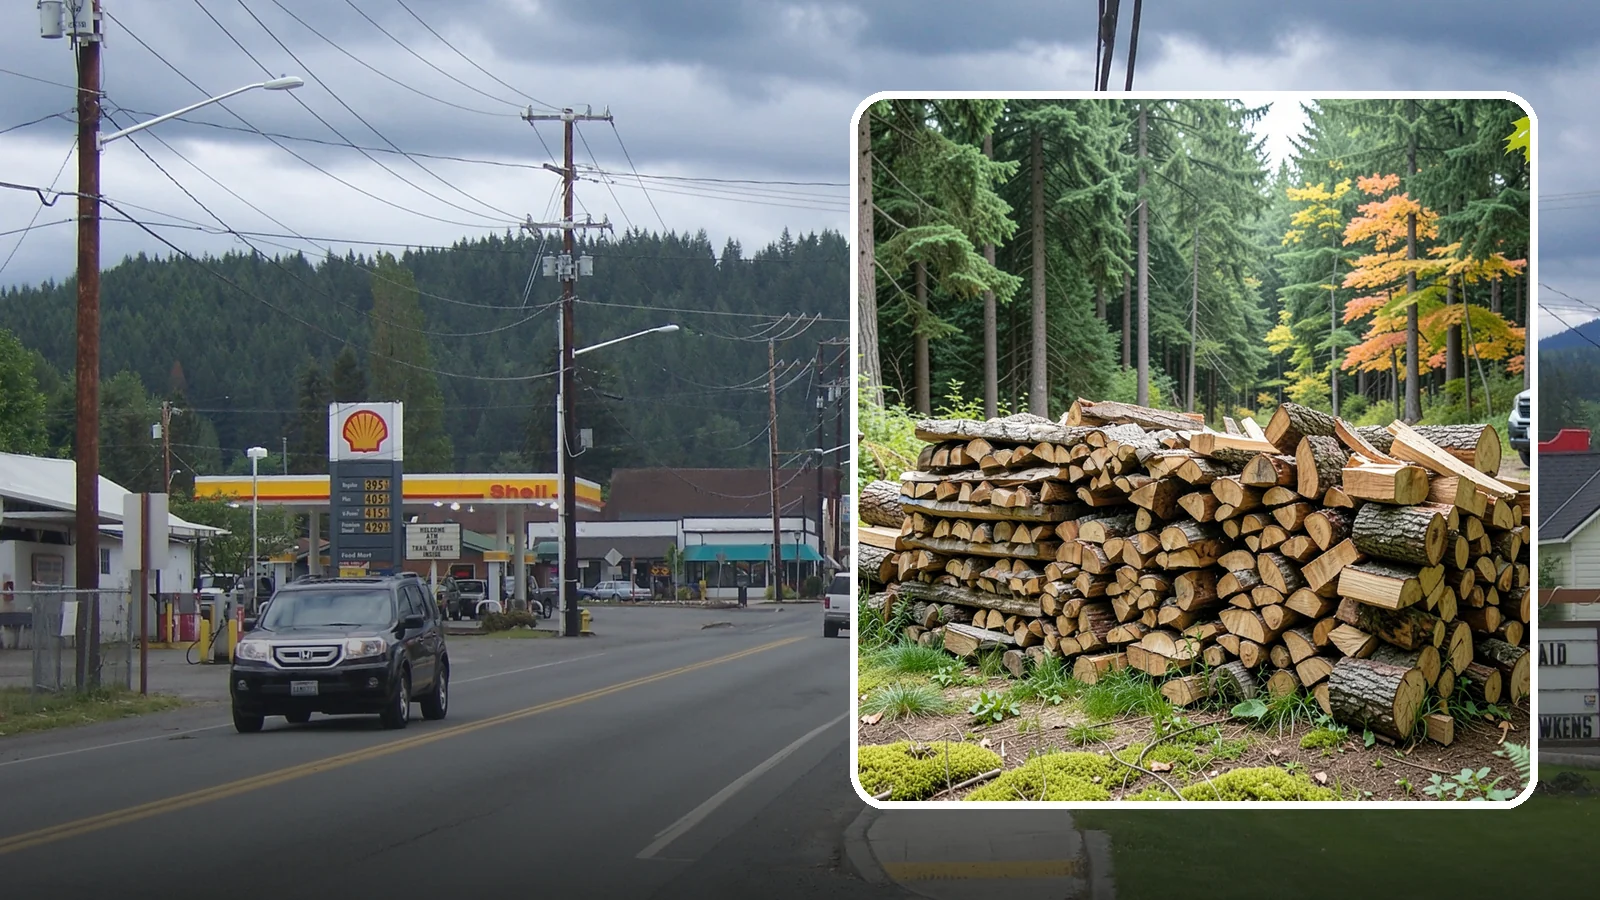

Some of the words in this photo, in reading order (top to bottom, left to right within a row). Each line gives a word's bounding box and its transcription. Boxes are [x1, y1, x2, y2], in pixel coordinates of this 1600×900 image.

[365, 480, 383, 490] 395
[490, 484, 547, 499] Shell
[365, 494, 383, 504] 405
[365, 508, 383, 518] 415
[365, 522, 383, 532] 429
